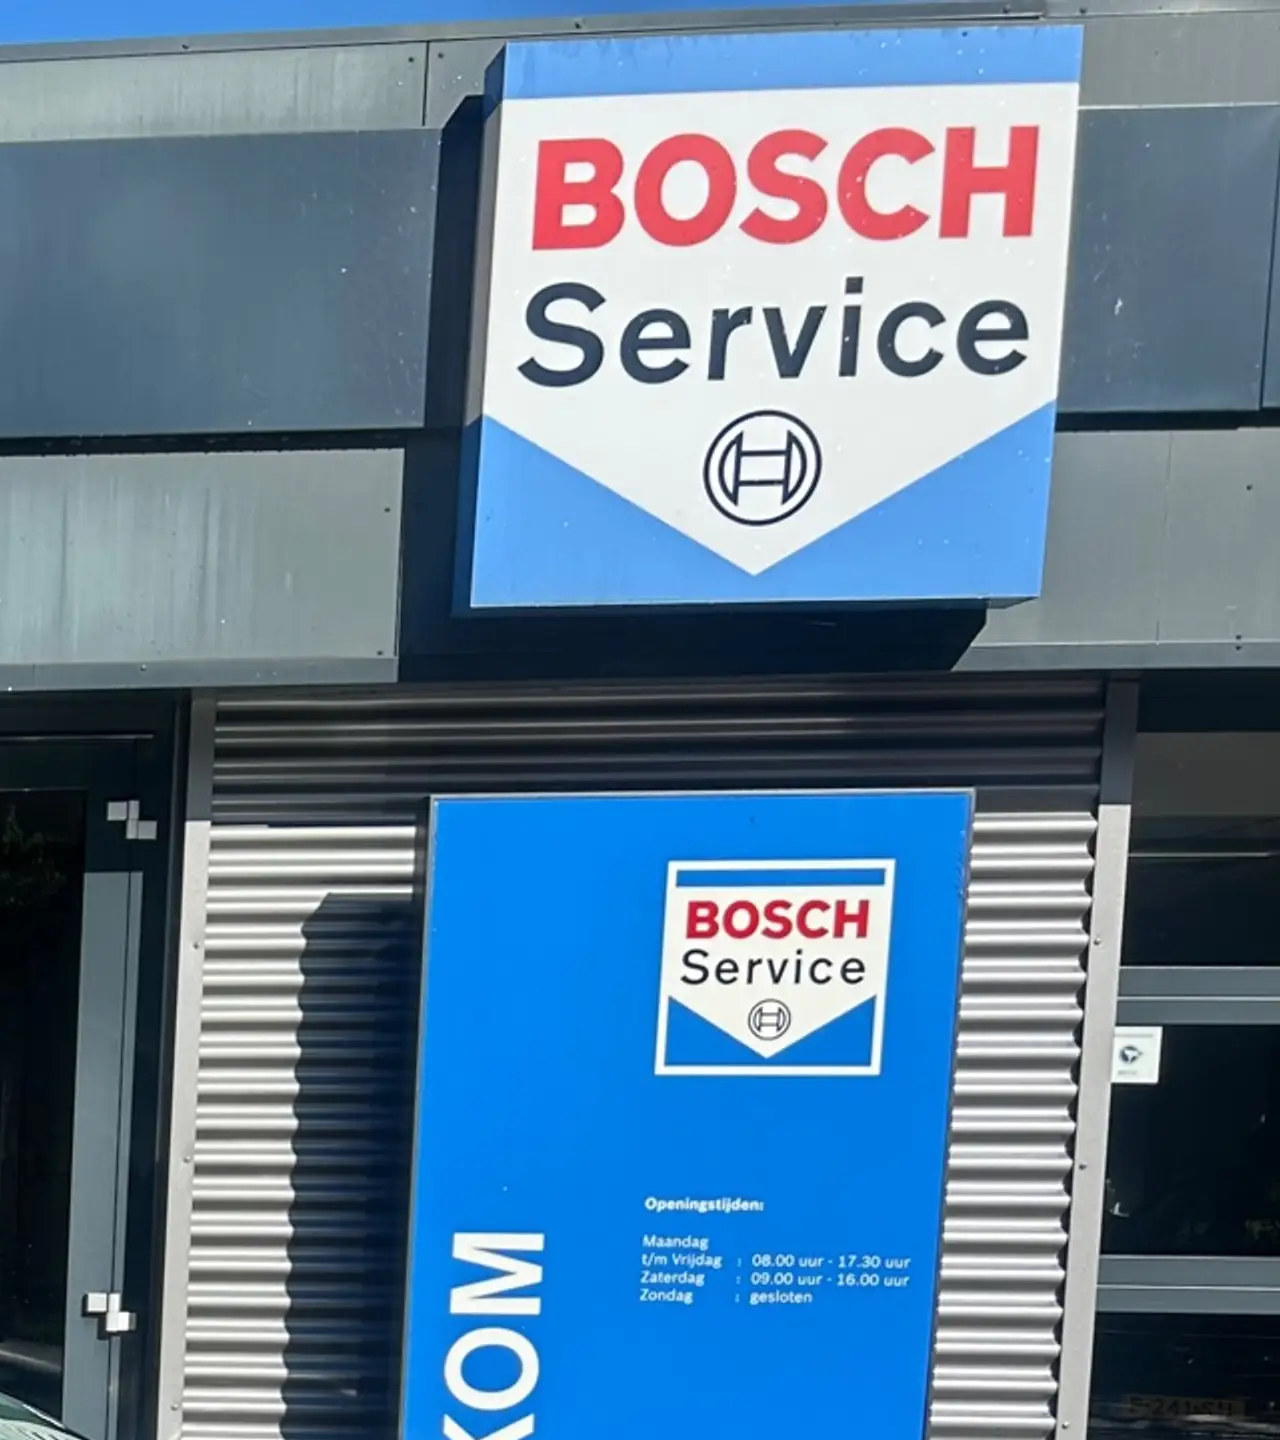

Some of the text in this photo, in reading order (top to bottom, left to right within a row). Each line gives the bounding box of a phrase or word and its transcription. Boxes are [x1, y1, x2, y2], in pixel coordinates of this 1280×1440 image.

[532, 124, 1040, 251] BOSCH
[517, 276, 1030, 389] Service
[684, 899, 870, 939] BOSCH
[680, 948, 867, 985] Service
[644, 1197, 764, 1213] Openingstijden:
[642, 1235, 709, 1250] Maandag
[641, 1252, 667, 1267] t/m
[671, 1252, 723, 1269] Vrijdag
[751, 1254, 794, 1268] 08.00
[798, 1257, 823, 1268] uur
[837, 1255, 881, 1269] 17.30
[885, 1258, 911, 1269] uur
[640, 1270, 705, 1286] Zaterdag
[750, 1272, 793, 1286] 09.00
[797, 1275, 822, 1286] uur
[836, 1273, 880, 1287] 16.00
[883, 1276, 910, 1287] uur
[639, 1288, 693, 1305] Zondag
[749, 1290, 813, 1306] gesloten
